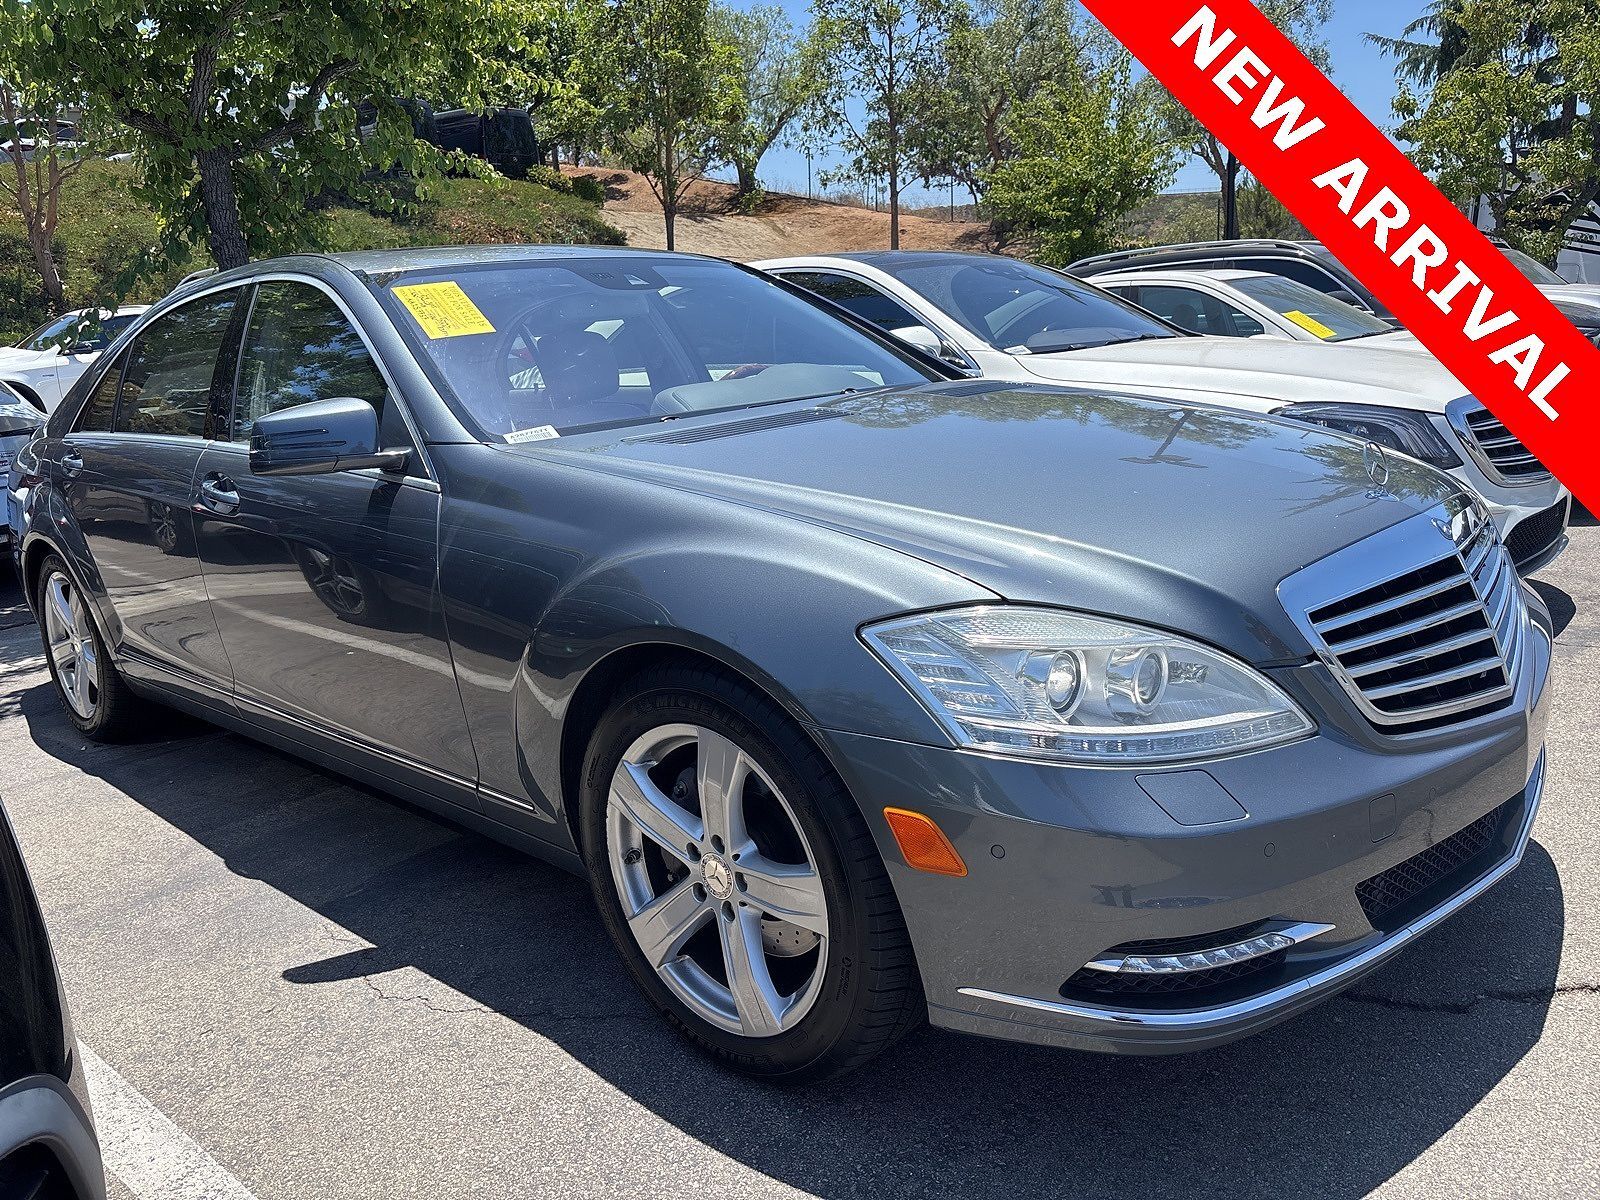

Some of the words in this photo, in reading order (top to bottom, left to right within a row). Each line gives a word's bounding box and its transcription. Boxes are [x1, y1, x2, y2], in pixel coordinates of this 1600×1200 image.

[439, 288, 455, 299] NOT
[459, 311, 475, 324] SALE
[447, 285, 462, 298] THIS
[458, 297, 481, 320] VEHICLE
[656, 695, 746, 734] MICHELIN
